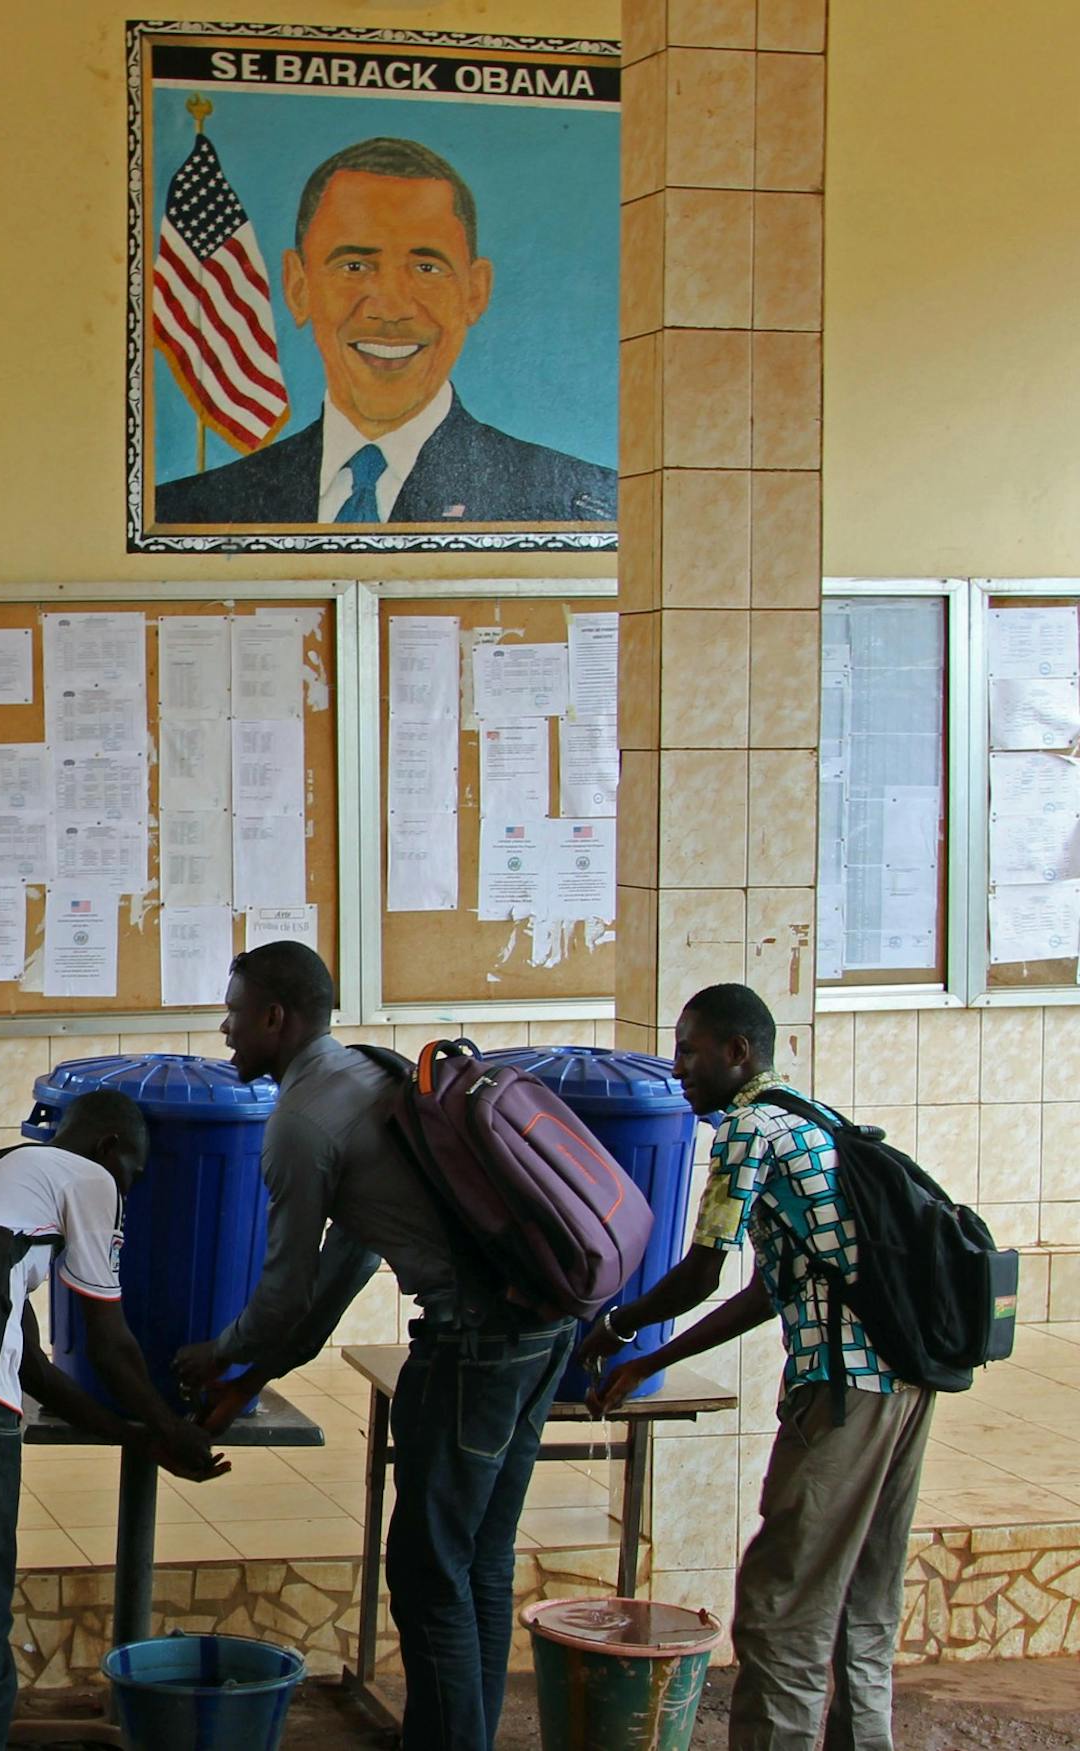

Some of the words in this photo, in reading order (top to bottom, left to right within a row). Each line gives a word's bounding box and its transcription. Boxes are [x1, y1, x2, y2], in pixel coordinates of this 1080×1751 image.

[210, 51, 268, 81] SE.
[275, 54, 438, 90] BARACK
[454, 65, 595, 96] OBAMA
